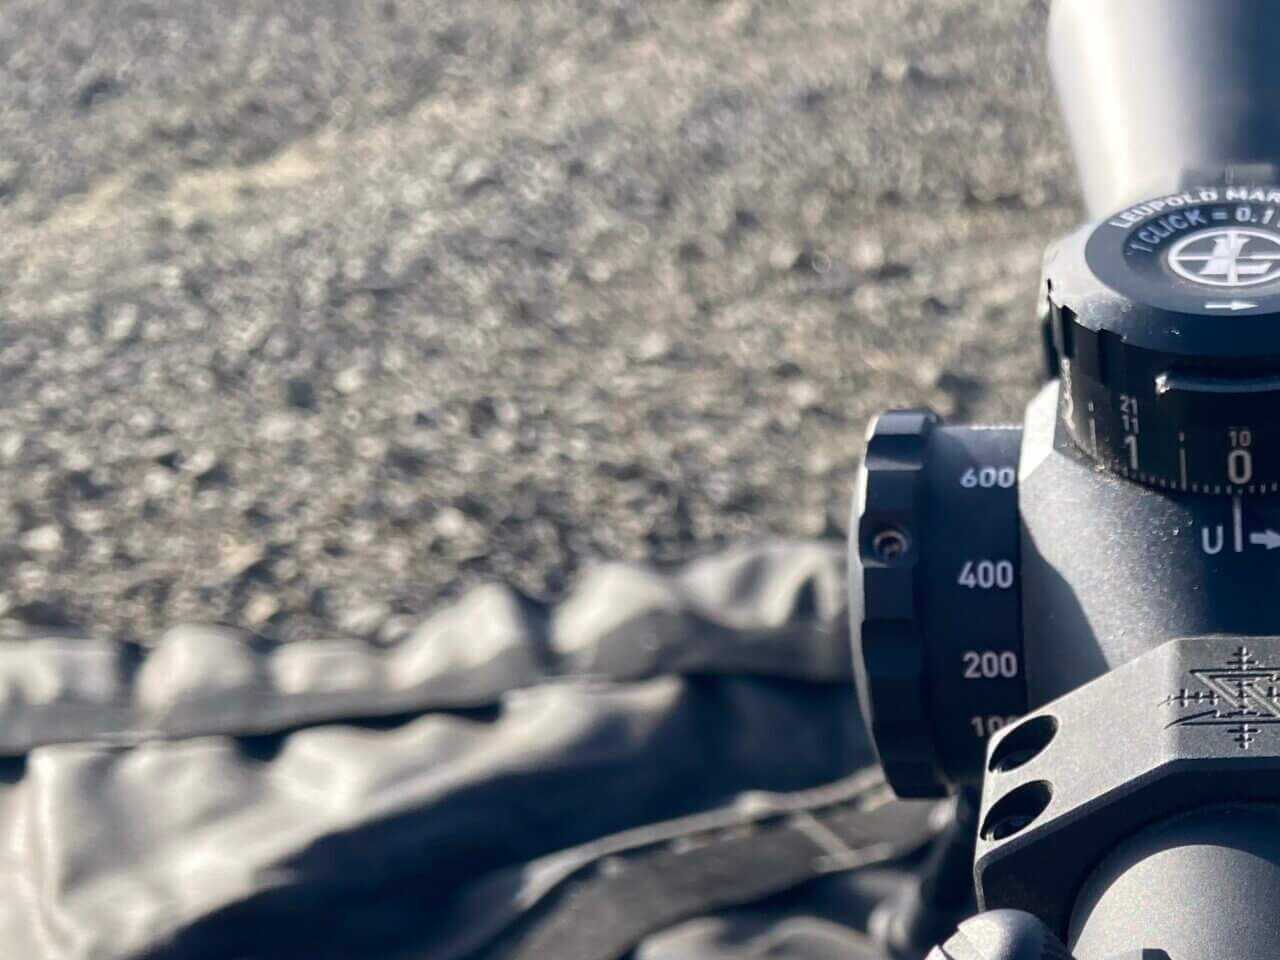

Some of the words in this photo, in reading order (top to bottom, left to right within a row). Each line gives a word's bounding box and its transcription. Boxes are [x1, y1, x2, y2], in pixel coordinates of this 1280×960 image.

[1109, 189, 1219, 229] LEUPOLD
[1138, 208, 1207, 246] CLICK
[1235, 206, 1275, 224] 0.1
[1227, 429, 1252, 448] 10
[1123, 435, 1139, 470] 1
[1226, 448, 1254, 486] 0
[959, 466, 1016, 489] 600
[1201, 524, 1224, 556] U
[957, 560, 1014, 589] 400
[962, 651, 1019, 679] 200
[970, 715, 1018, 737] 10
